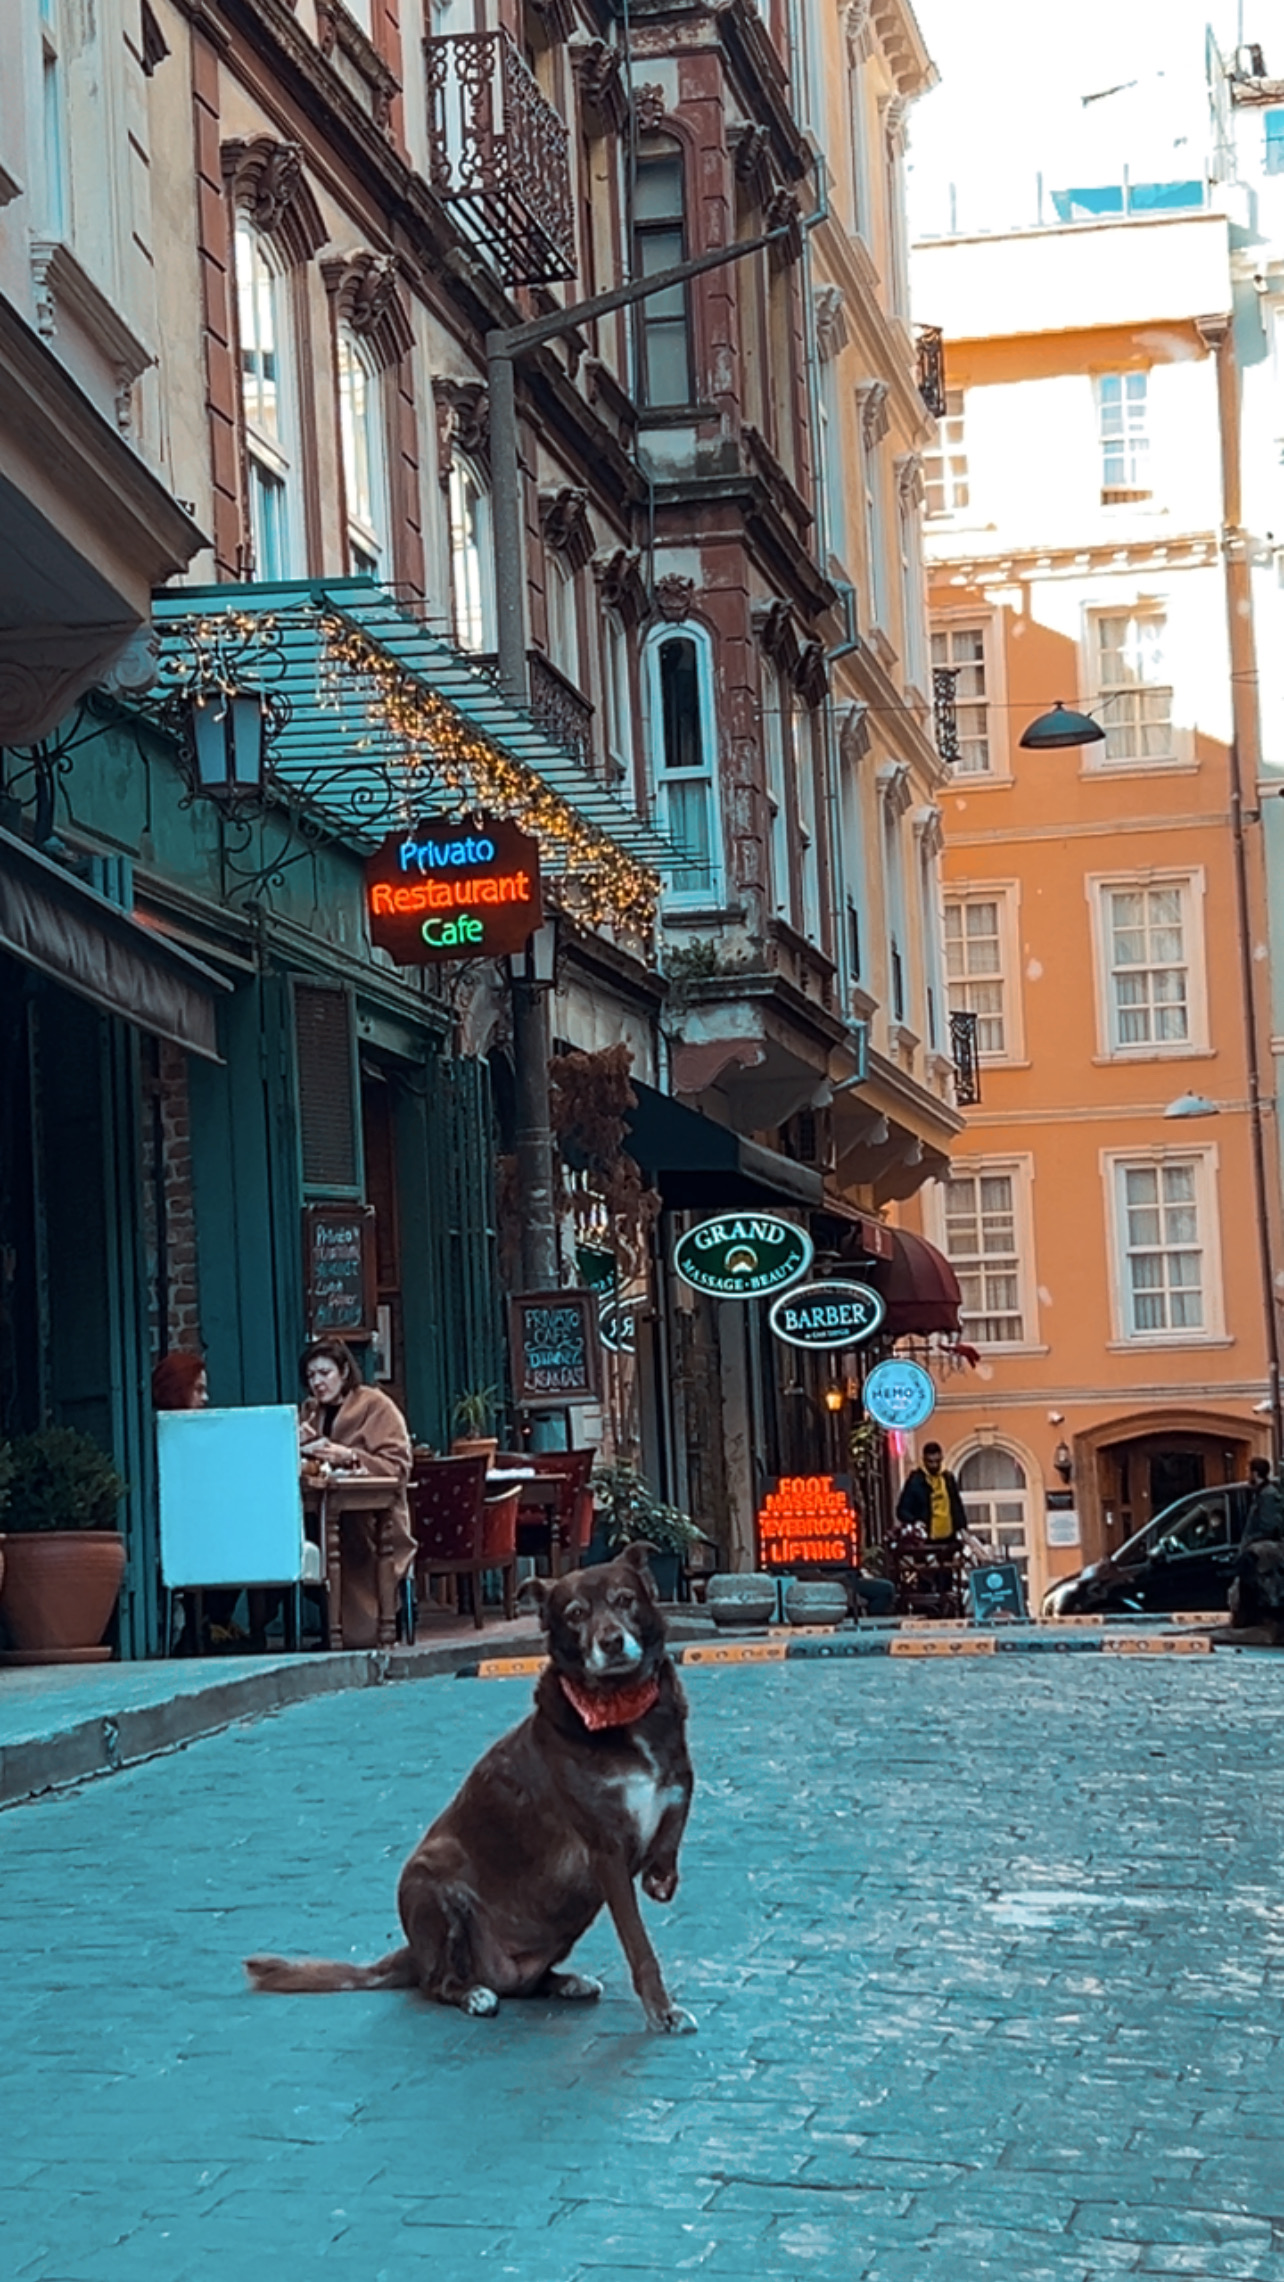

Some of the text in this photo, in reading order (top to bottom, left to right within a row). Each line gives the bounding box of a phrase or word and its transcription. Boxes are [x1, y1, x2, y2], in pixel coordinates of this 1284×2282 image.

[399, 837, 495, 872] Privato
[371, 871, 530, 915] Restaurant
[421, 913, 484, 947] Cafe
[694, 1220, 786, 1250] GRAND
[784, 1302, 868, 1331] BARBER
[778, 1476, 834, 1495] FOOT
[766, 1491, 847, 1510] MASSAGE
[764, 1516, 852, 1537] EYEBROW
